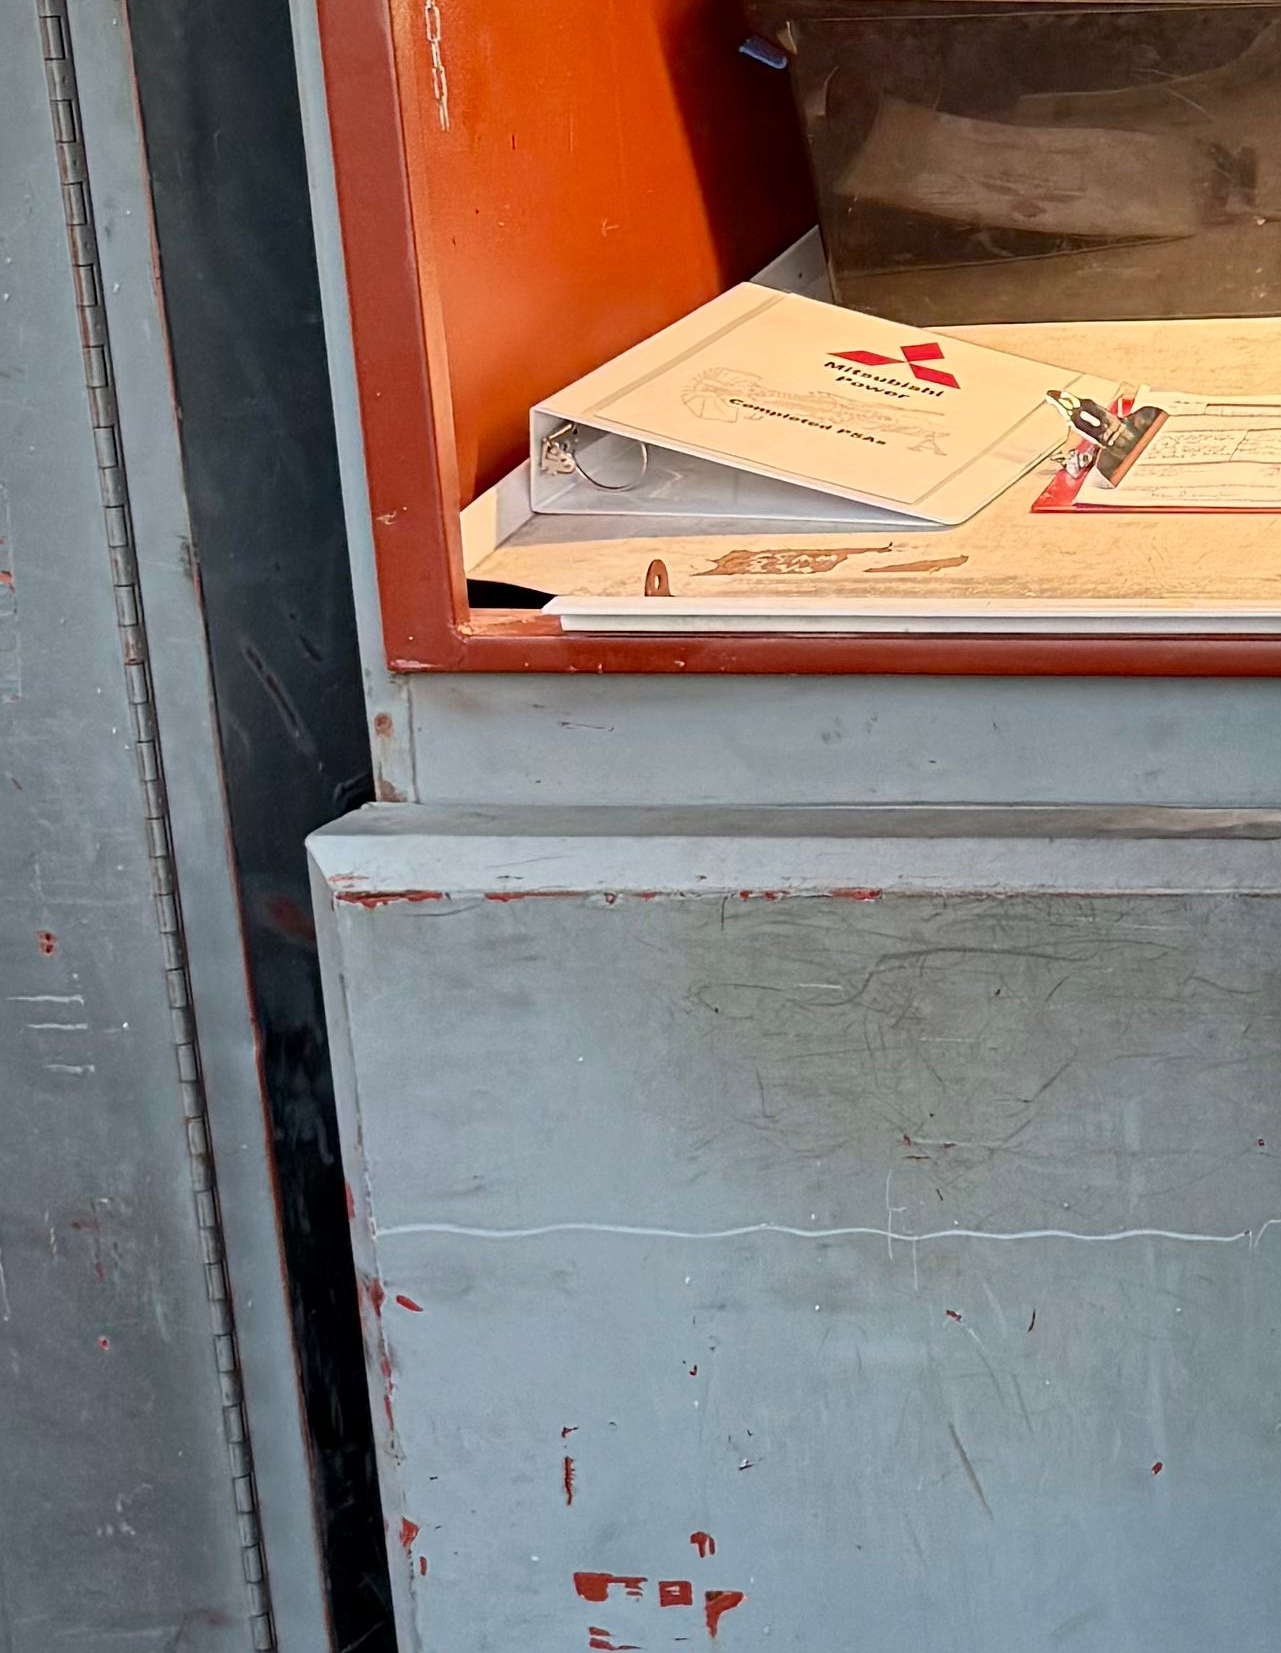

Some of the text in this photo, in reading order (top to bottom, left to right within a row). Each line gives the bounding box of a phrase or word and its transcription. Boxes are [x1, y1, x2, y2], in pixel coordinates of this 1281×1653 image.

[823, 361, 945, 398] Mitsubishi
[835, 375, 911, 400] Power
[728, 397, 833, 432] Completed
